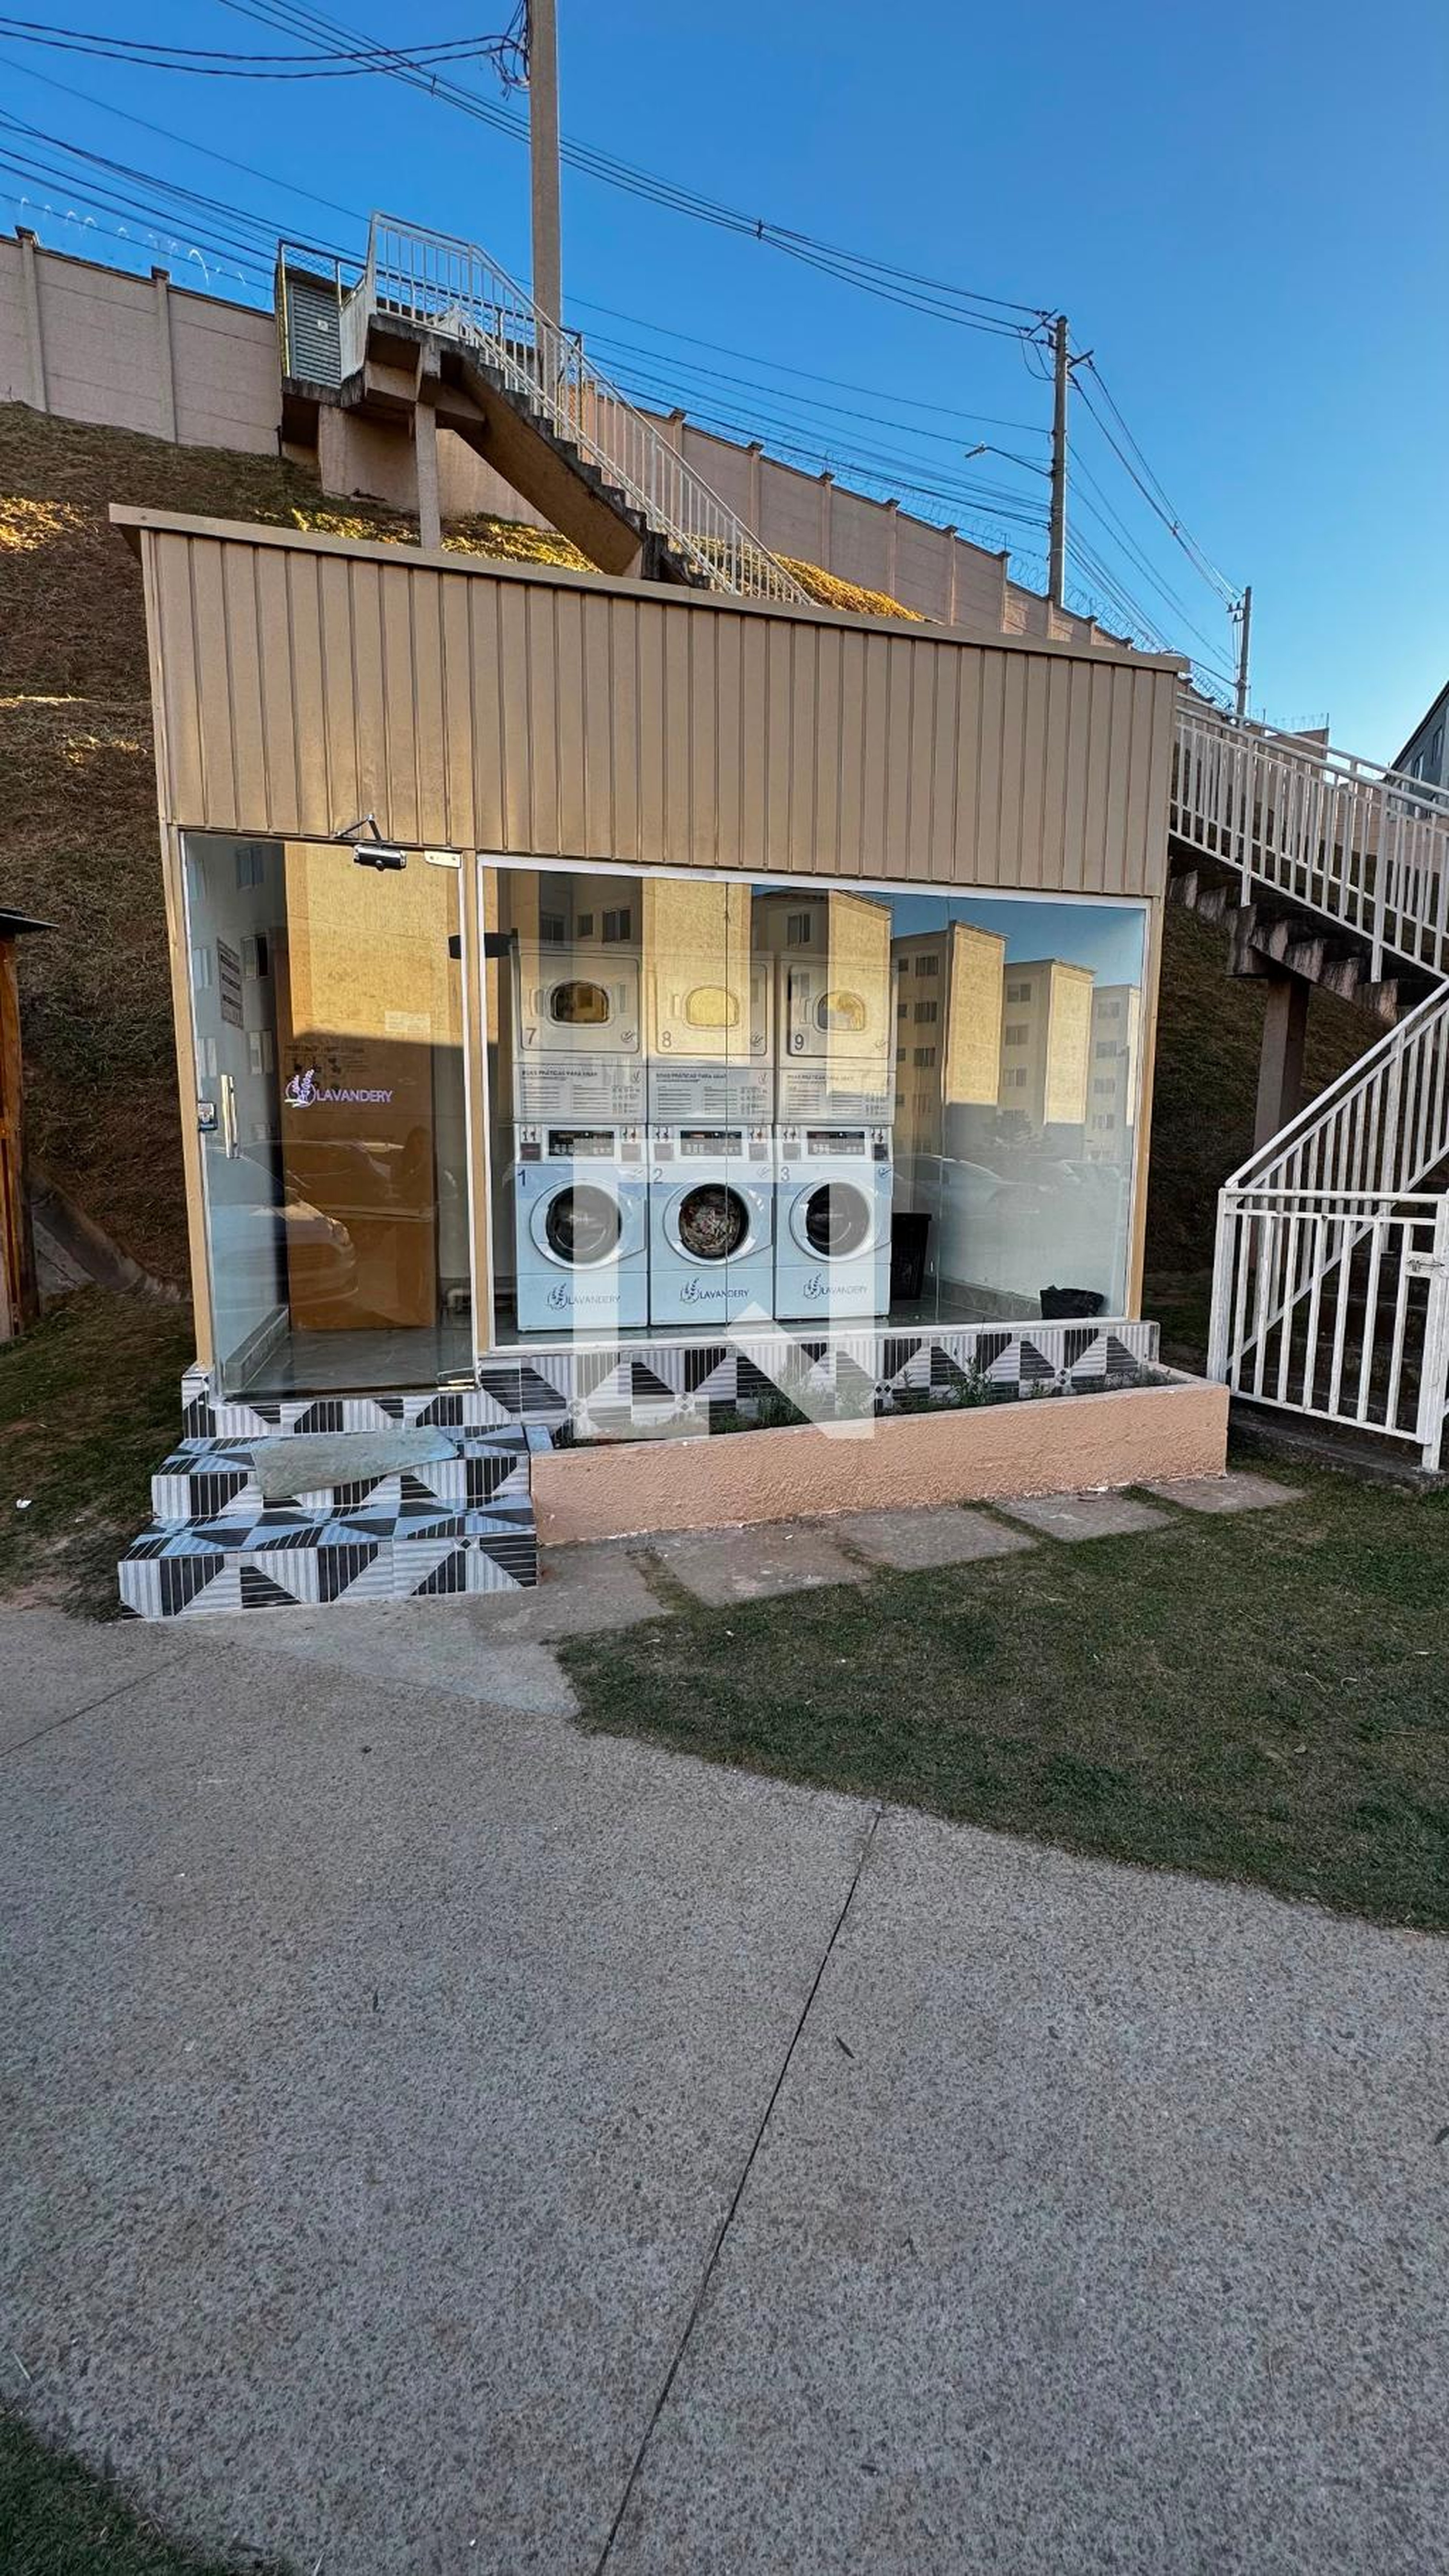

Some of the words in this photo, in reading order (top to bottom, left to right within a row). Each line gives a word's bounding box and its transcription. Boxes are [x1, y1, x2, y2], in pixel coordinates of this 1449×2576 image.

[526, 1028, 537, 1045] 7
[662, 1031, 671, 1048] 8
[795, 1034, 804, 1050] 9
[317, 1090, 393, 1103] LAVANDERY
[518, 1170, 525, 1187] 1
[654, 1168, 663, 1184] 2
[781, 1167, 790, 1181] 3
[568, 1295, 621, 1305] LAVANDERY
[700, 1289, 749, 1299] LAVANDERY
